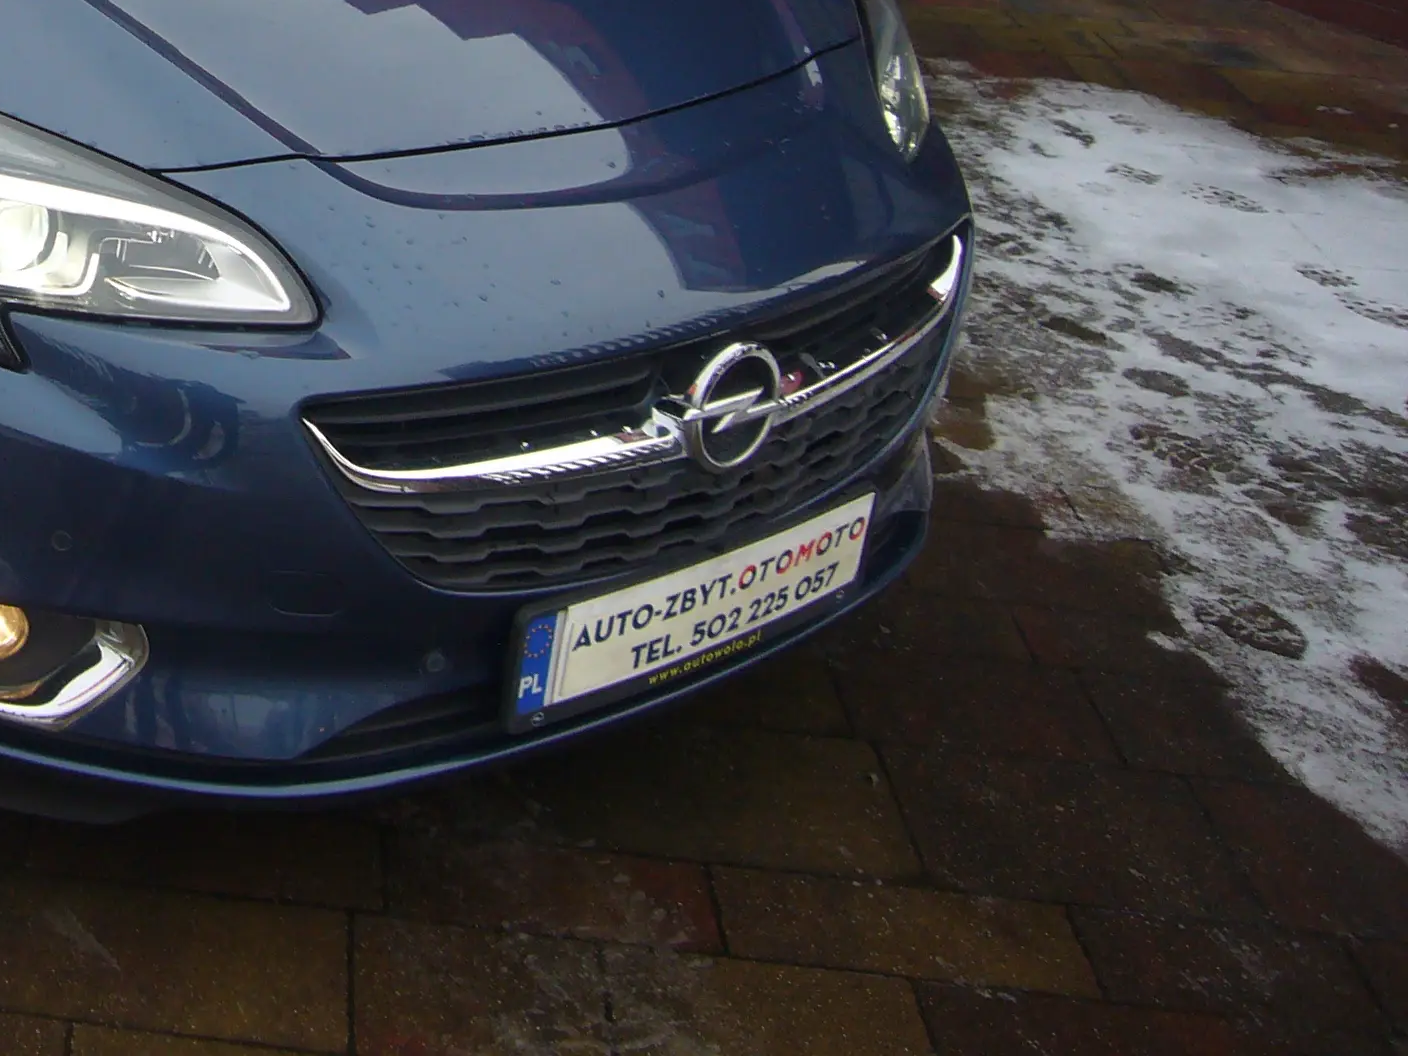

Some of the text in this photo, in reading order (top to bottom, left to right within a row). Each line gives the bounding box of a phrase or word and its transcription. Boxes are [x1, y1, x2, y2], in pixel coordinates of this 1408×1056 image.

[572, 516, 866, 651] AUTO-ZBYT.OTOMOTO
[631, 562, 840, 669] TEL. 502 225 057
[518, 673, 542, 699] PL
[648, 629, 762, 685] www.autowola.pl
